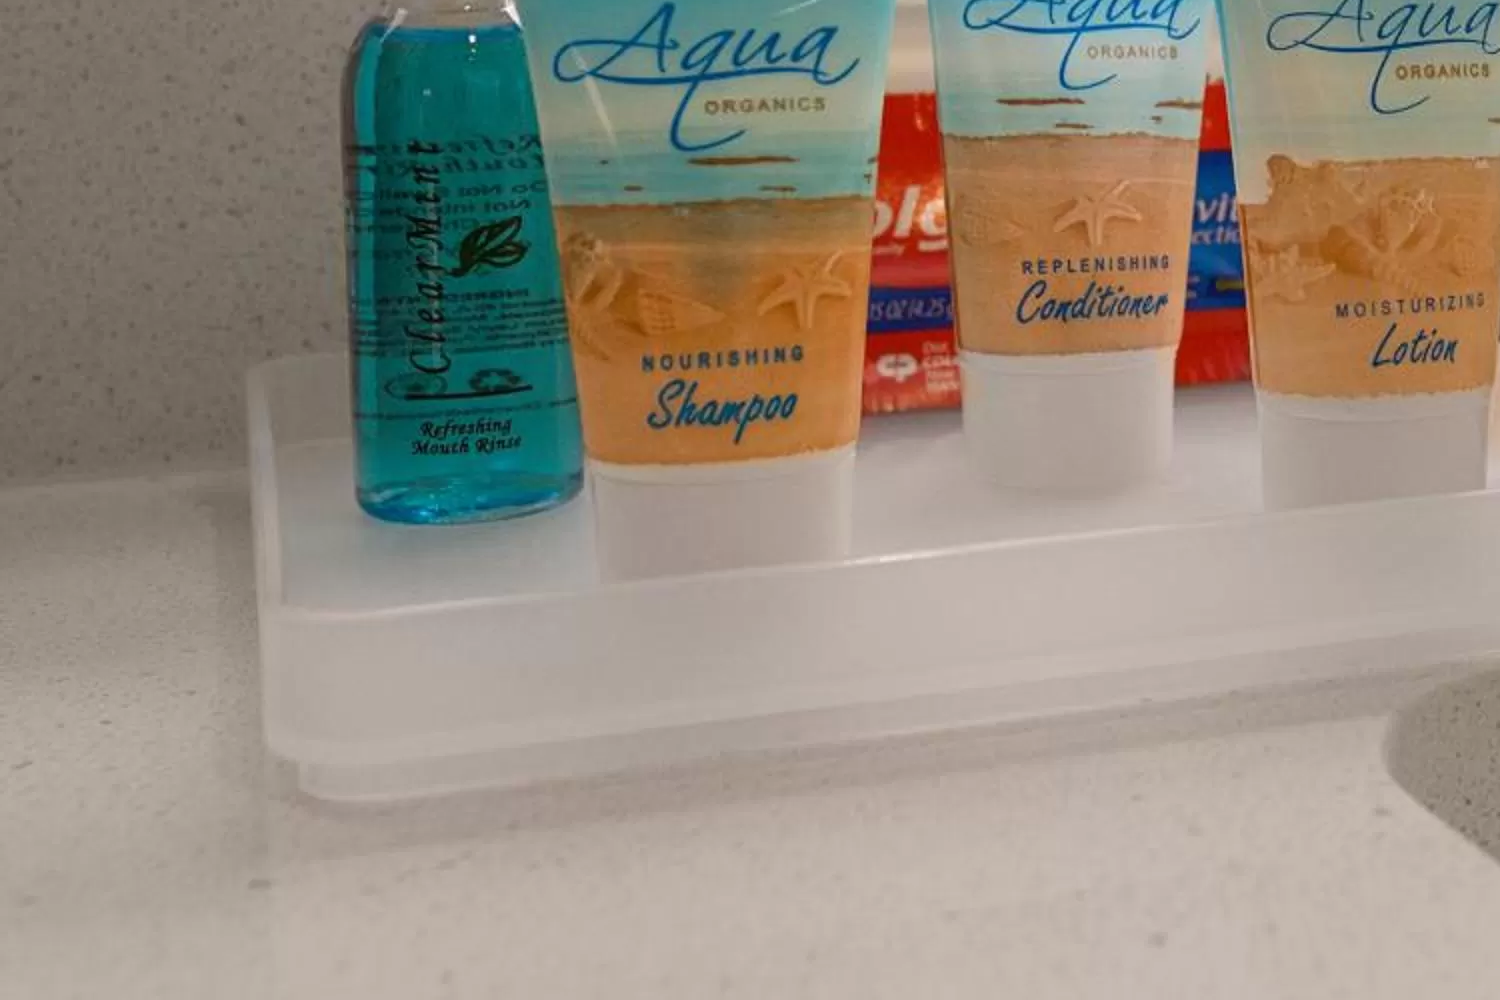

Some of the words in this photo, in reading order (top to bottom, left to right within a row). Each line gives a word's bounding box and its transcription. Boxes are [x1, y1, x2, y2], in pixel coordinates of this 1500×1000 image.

[1086, 44, 1179, 61] ORGANICS
[553, 0, 861, 152] Aqua
[1395, 63, 1491, 81] ORGANICS
[703, 96, 827, 116] ORGANICS
[1021, 254, 1169, 275] REPLENISHING
[1016, 279, 1170, 325] Conditioner
[1335, 291, 1486, 319] MOISTURIZING
[641, 344, 804, 372] NOURISHING
[1371, 322, 1459, 369] Lotion
[647, 378, 799, 446] Shampoo
[418, 418, 513, 441] Refreshing
[411, 438, 469, 456] Mouth
[476, 435, 522, 455] Rinse
